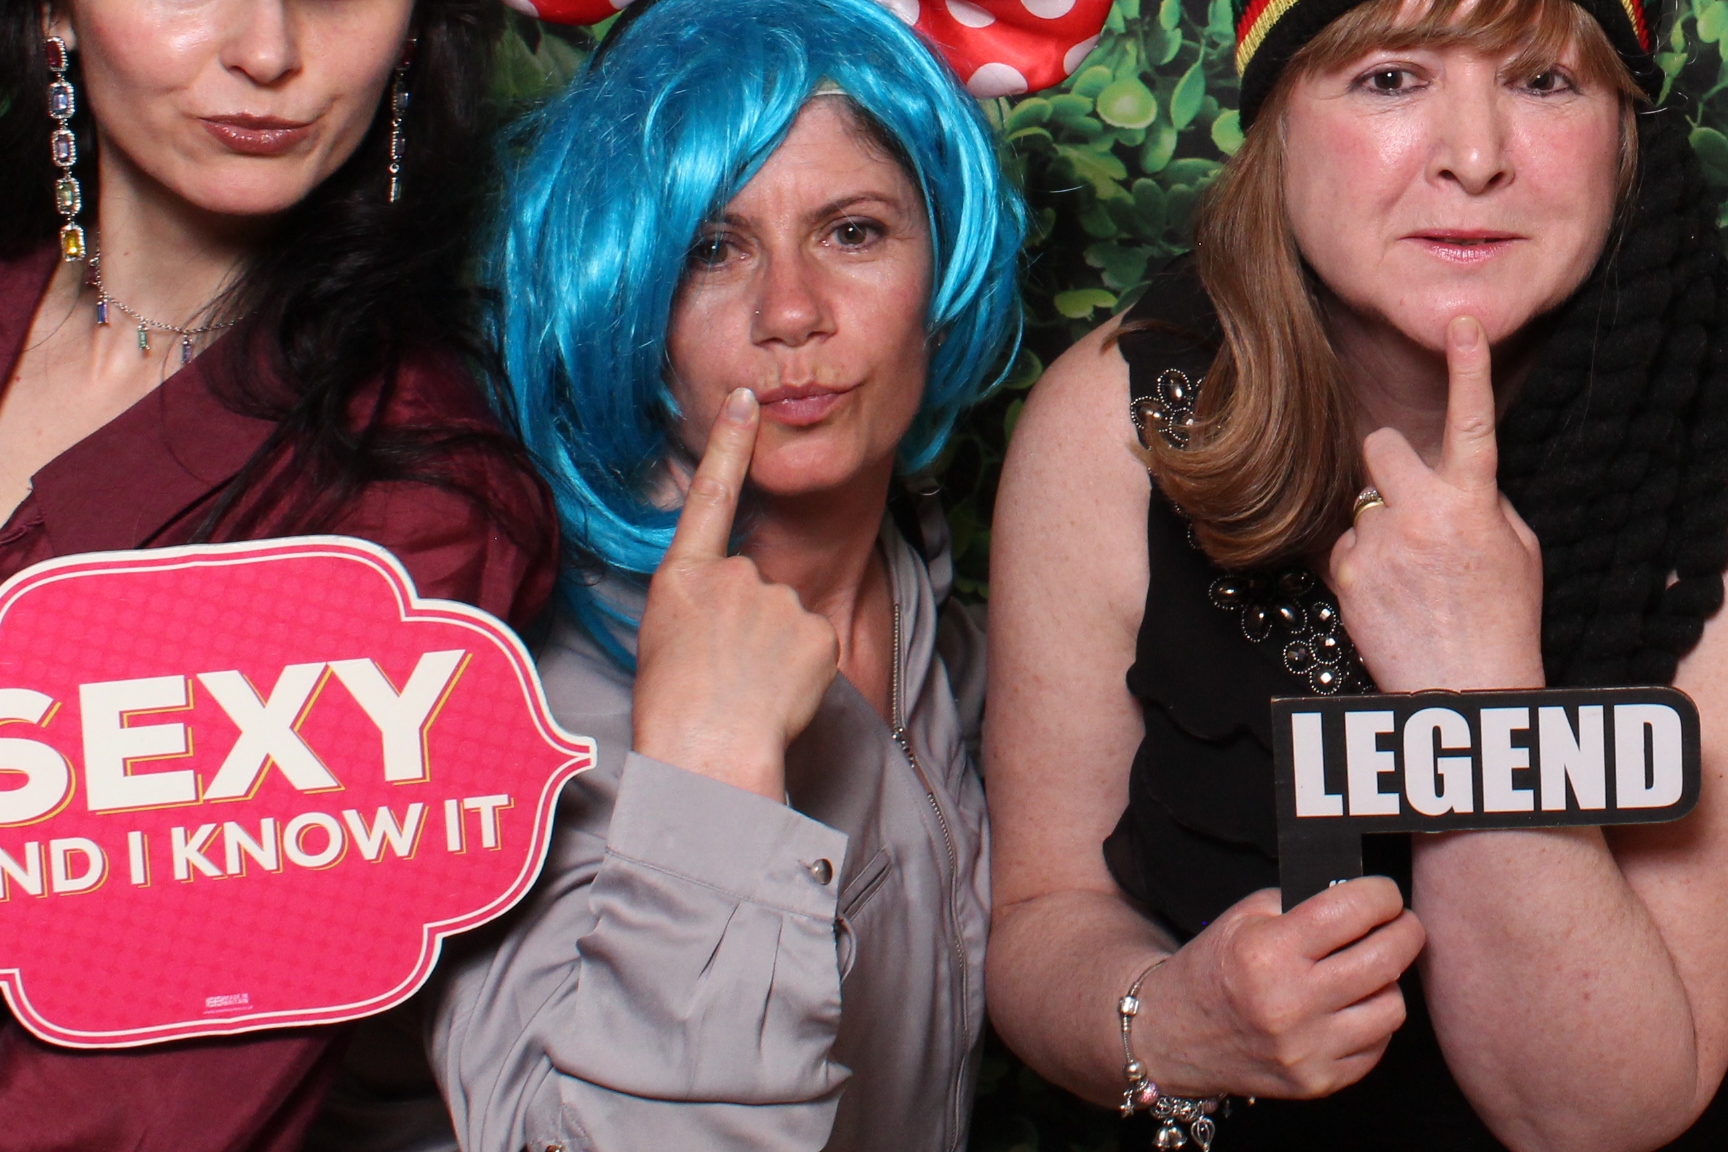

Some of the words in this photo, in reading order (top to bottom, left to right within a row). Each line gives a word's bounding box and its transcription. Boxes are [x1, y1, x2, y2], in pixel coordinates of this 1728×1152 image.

[0, 649, 469, 825] SEXY
[1291, 703, 1684, 818] LEGEND
[128, 831, 148, 886] I
[172, 802, 426, 881] KNOW
[444, 794, 511, 853] IT
